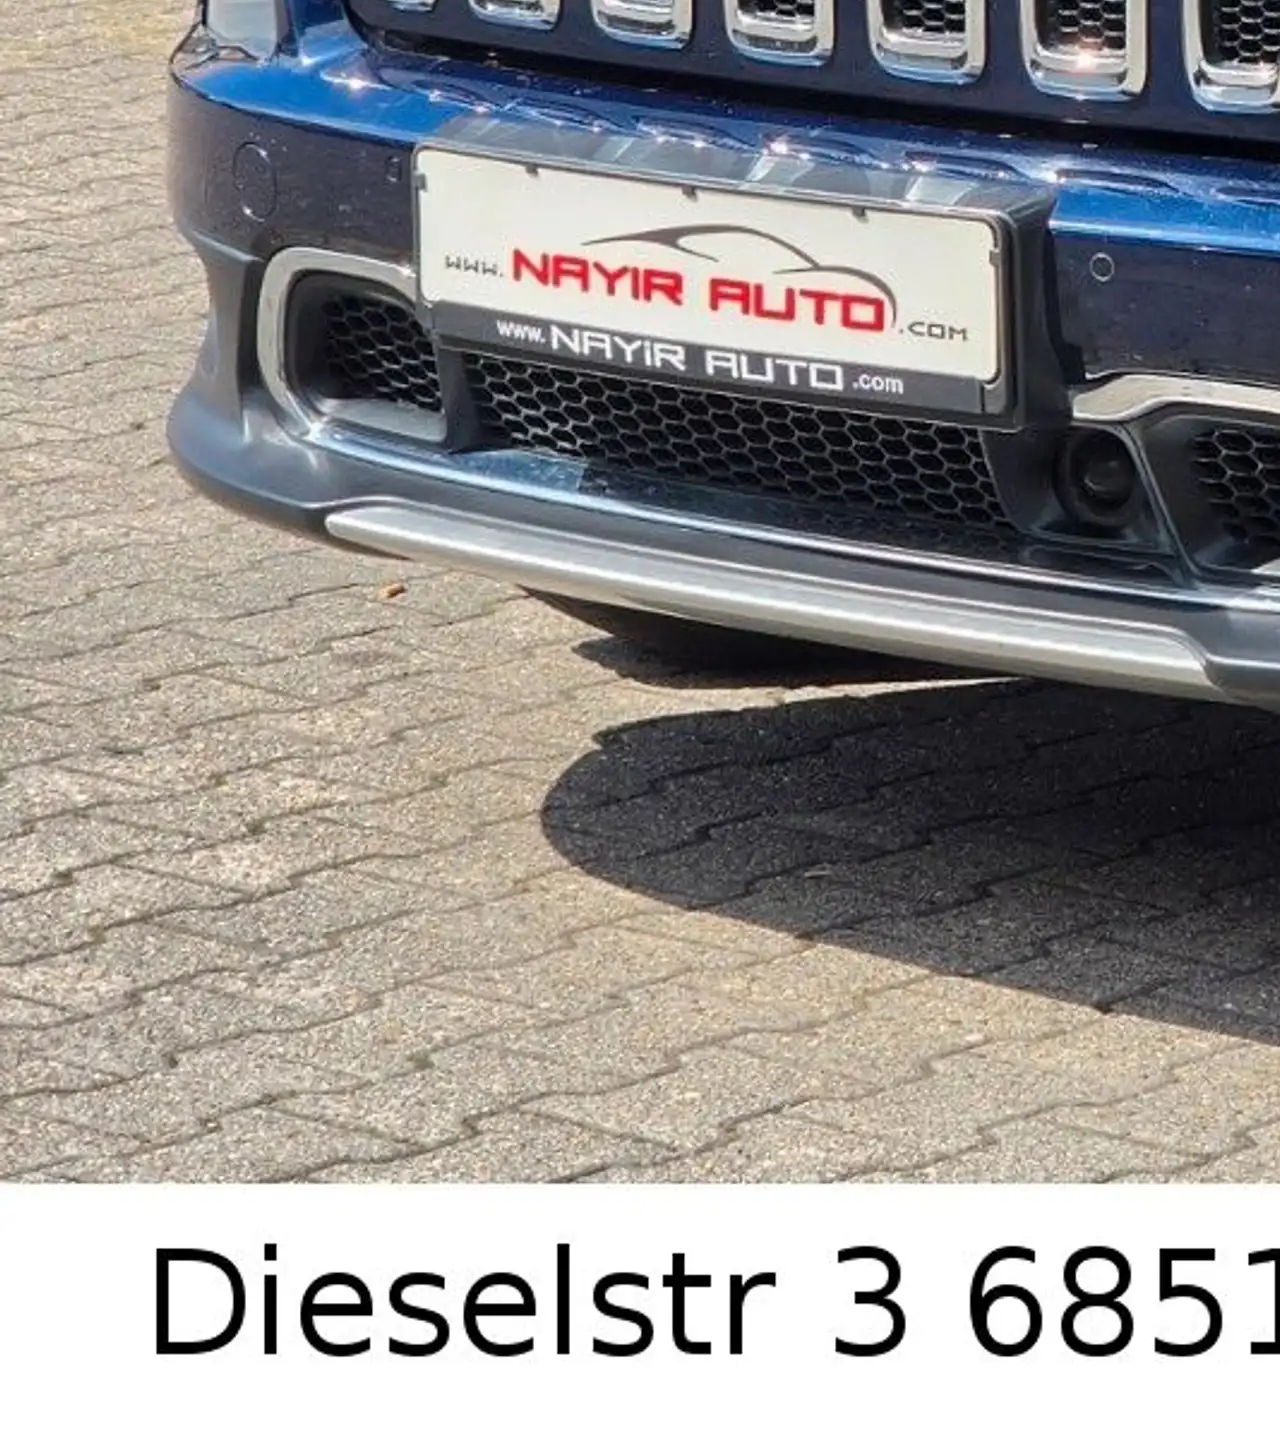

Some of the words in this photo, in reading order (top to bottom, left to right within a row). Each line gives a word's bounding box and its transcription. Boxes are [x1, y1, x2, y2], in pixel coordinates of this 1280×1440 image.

[512, 247, 684, 307] NAYIR
[709, 277, 886, 333] AUTO
[704, 349, 844, 391] AUTO
